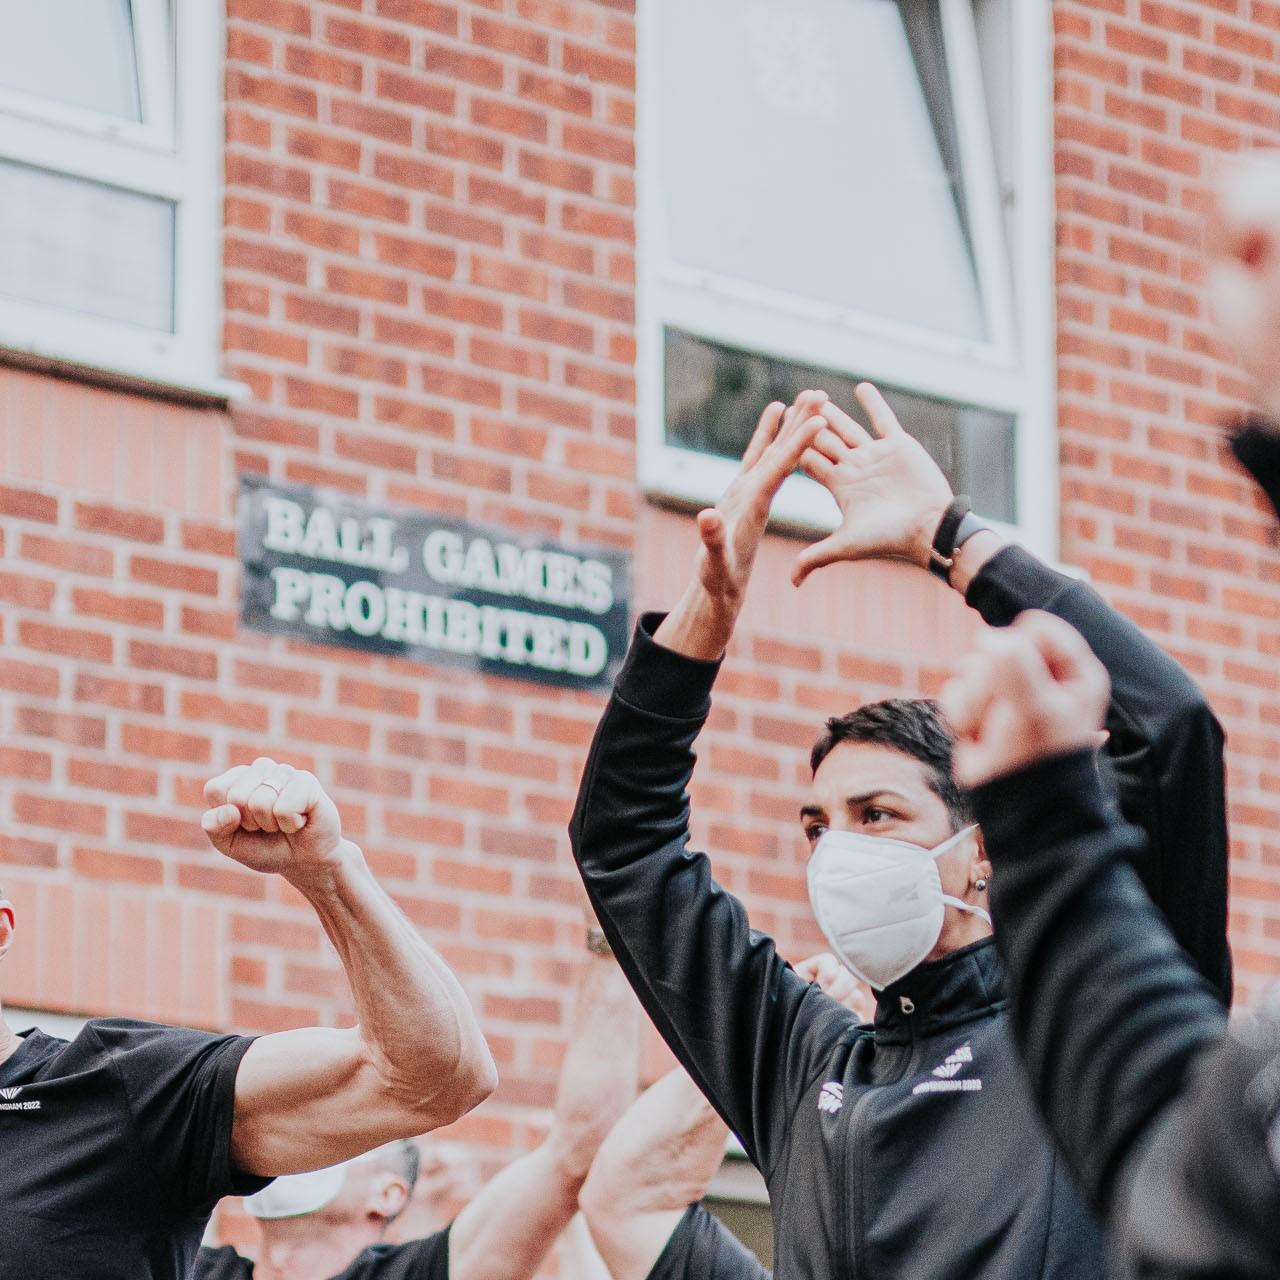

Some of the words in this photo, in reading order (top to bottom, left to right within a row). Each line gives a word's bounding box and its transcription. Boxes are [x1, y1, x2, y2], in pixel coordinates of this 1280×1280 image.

[263, 498, 409, 573] BALL
[423, 529, 615, 614] GAMES
[269, 566, 609, 677] PROHIBITED
[23, 1100, 41, 1110] 2022
